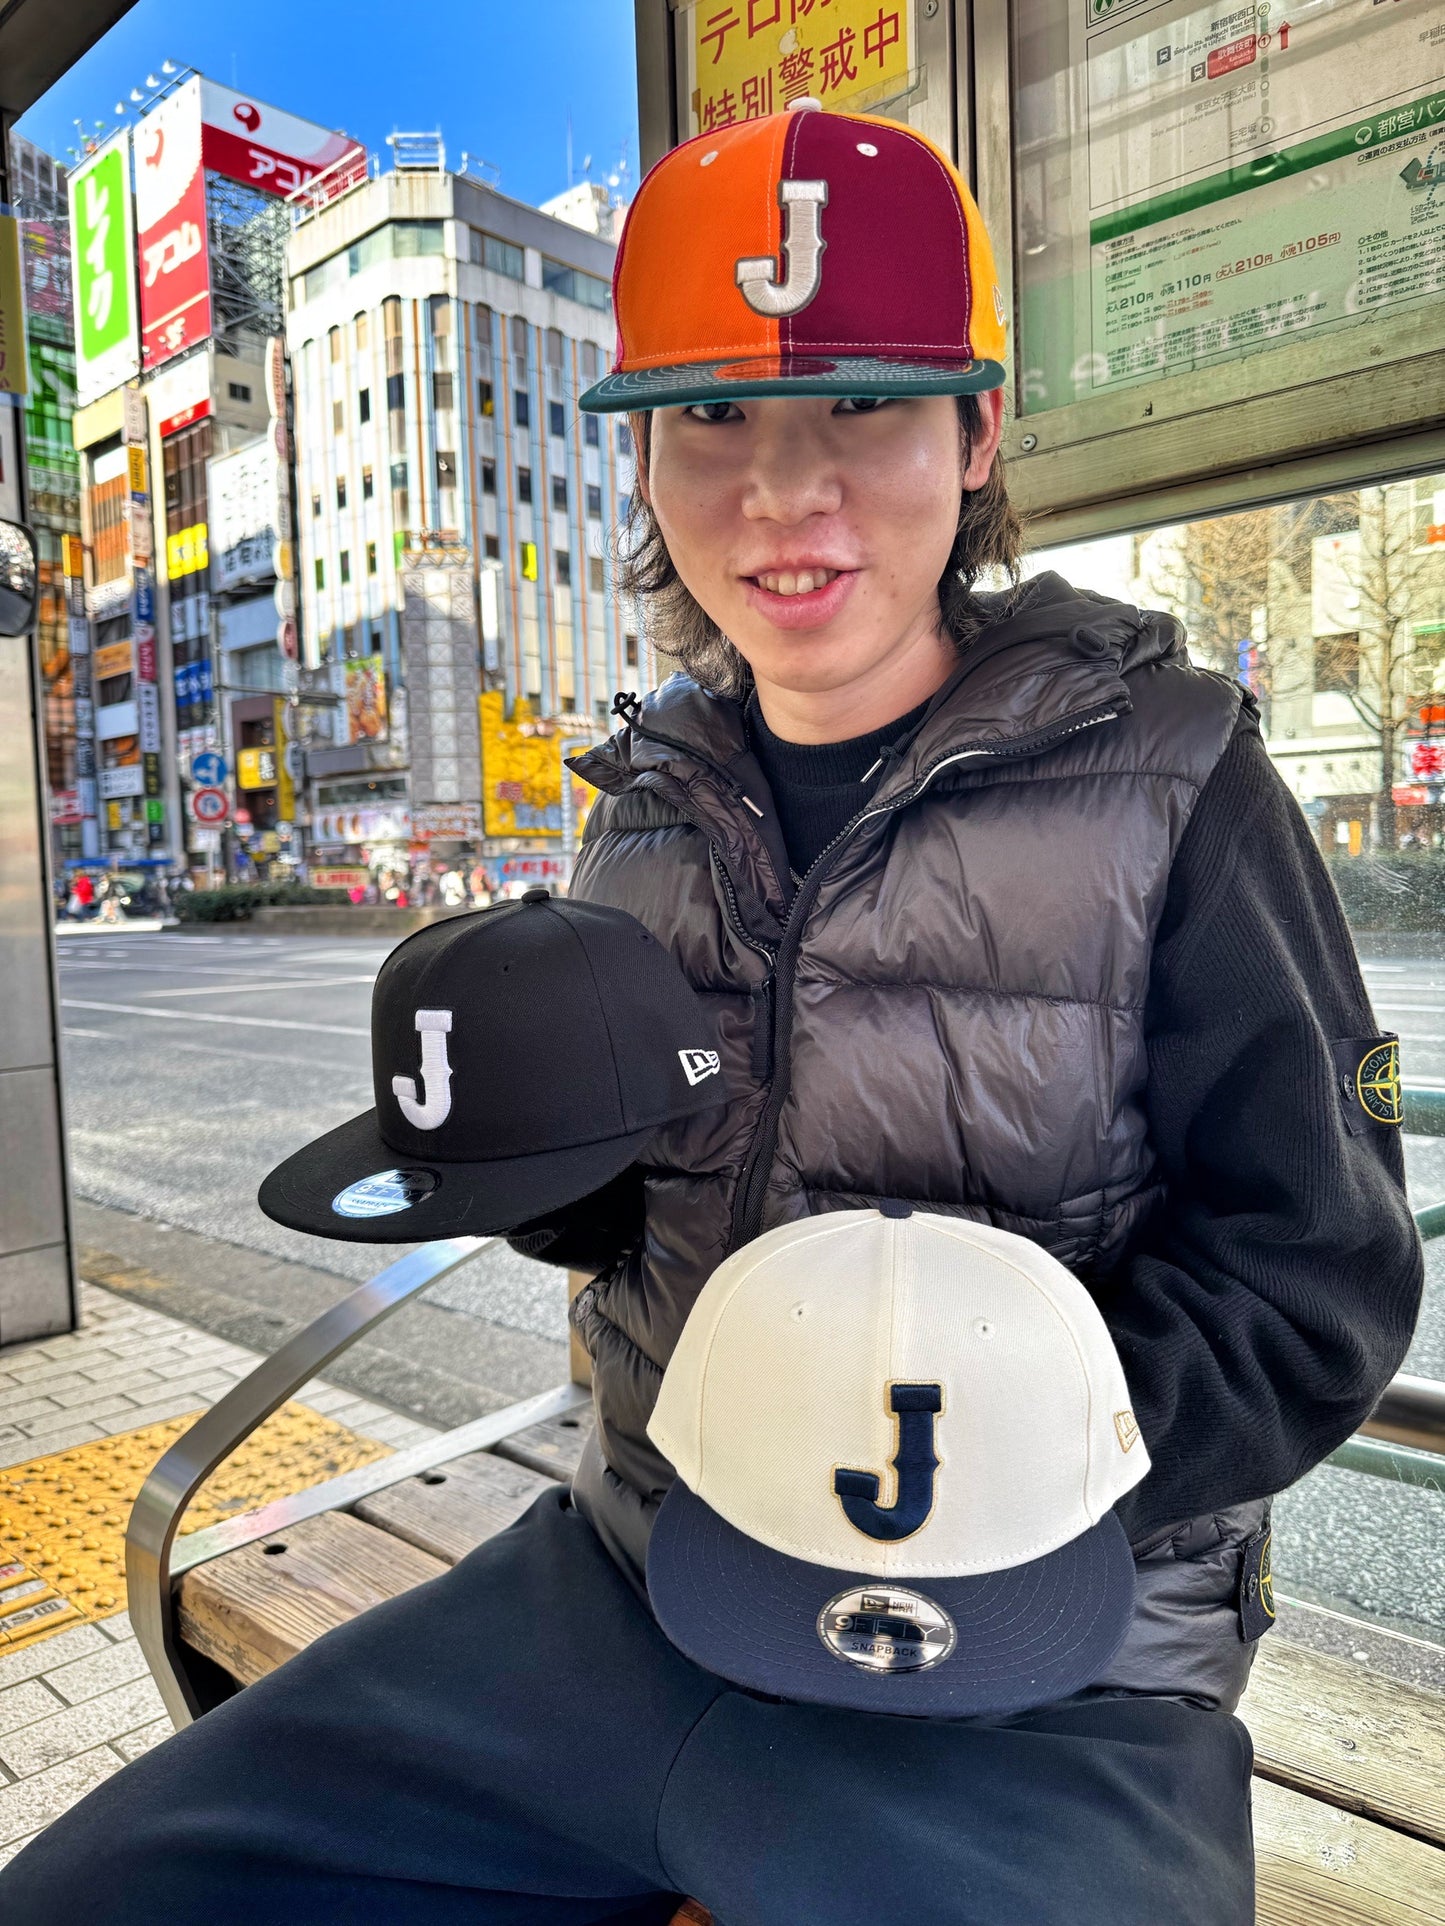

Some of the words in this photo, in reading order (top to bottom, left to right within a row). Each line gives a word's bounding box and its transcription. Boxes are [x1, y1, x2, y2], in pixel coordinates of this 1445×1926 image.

[700, 0, 834, 64] テロ
[703, 8, 899, 131] 特別警戒中
[84, 174, 113, 332] レイク
[143, 220, 201, 288] アコム
[735, 180, 828, 317] J
[392, 1009, 454, 1131] J
[1363, 1049, 1390, 1080] STONE
[1364, 1088, 1393, 1116] ISLAND
[830, 1379, 946, 1544] J
[835, 1615, 937, 1641] 9FIFTY
[851, 1641, 918, 1657] SNAPBACK
